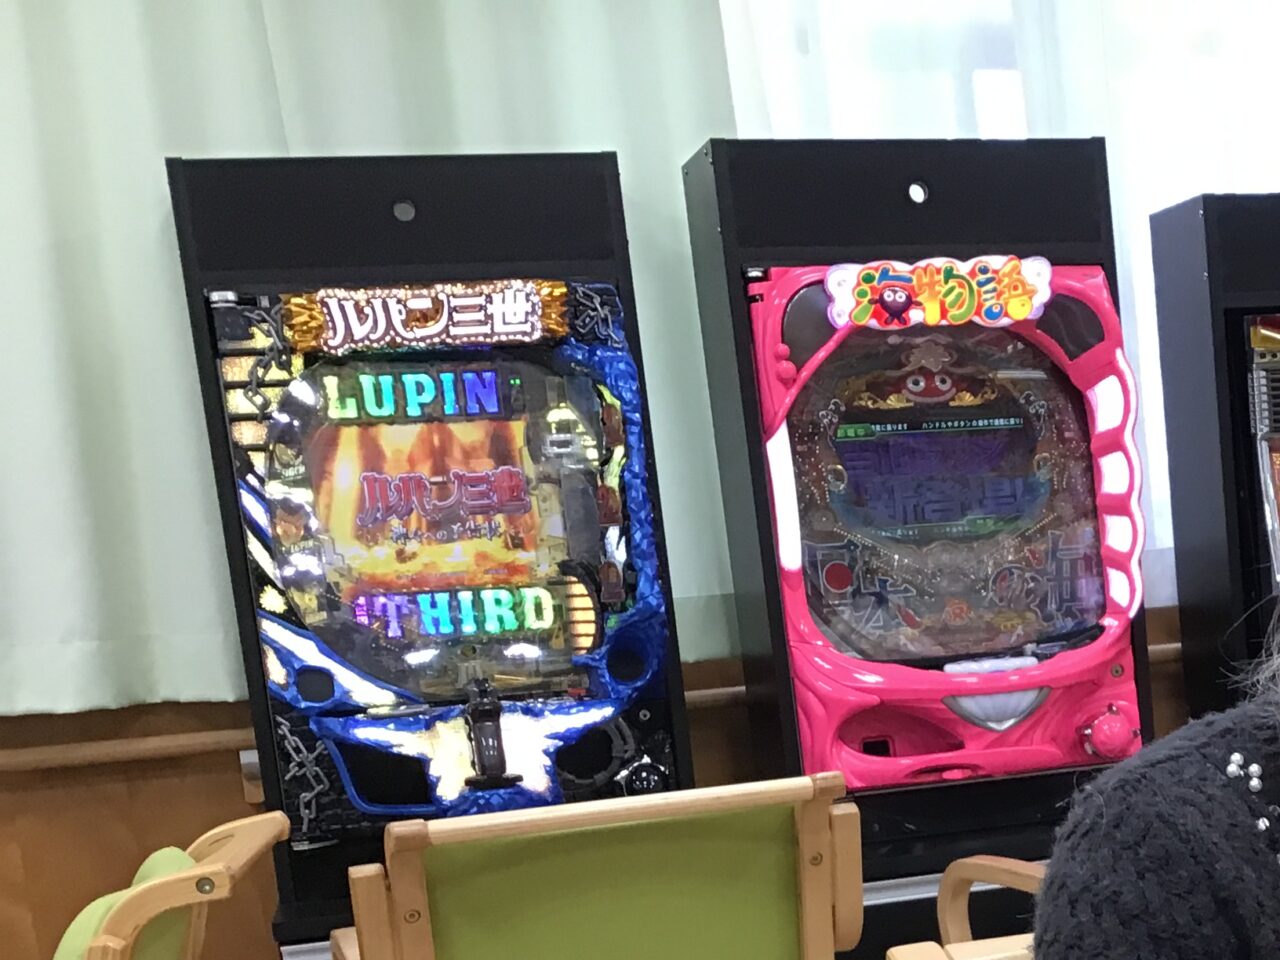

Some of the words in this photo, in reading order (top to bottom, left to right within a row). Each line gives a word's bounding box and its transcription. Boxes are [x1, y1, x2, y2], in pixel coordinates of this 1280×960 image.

[322, 288, 533, 347] ルパン三世
[322, 371, 499, 419] LUPIN
[372, 586, 554, 638] THIRD
